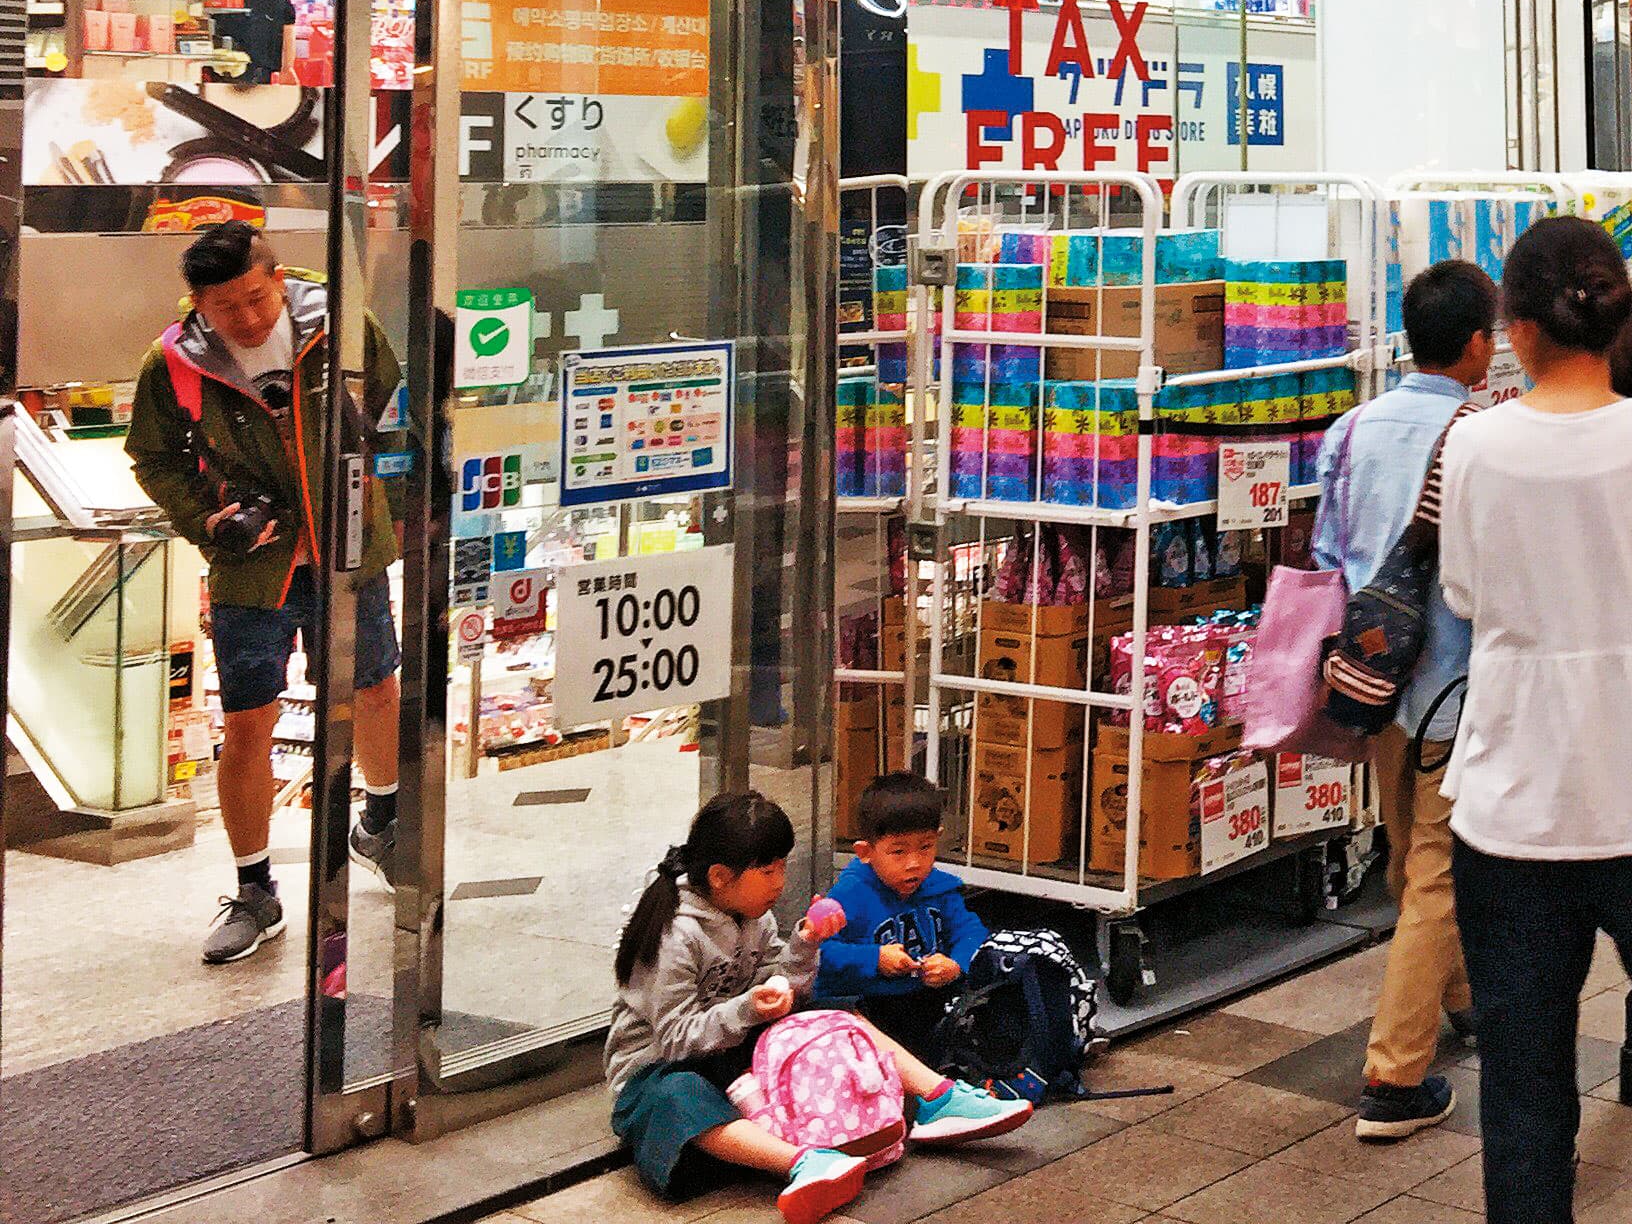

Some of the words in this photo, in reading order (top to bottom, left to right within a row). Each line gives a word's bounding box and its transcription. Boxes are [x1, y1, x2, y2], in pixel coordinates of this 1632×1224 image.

[513, 95, 604, 131] くすり
[515, 143, 601, 162] pharmacy
[966, 109, 1174, 197] FREE
[1249, 481, 1281, 508] 187
[577, 572, 639, 597] 営業時間
[594, 584, 701, 641] 10:00
[591, 644, 700, 704] 25:00
[1304, 781, 1344, 811] 380
[1228, 804, 1261, 841] 380
